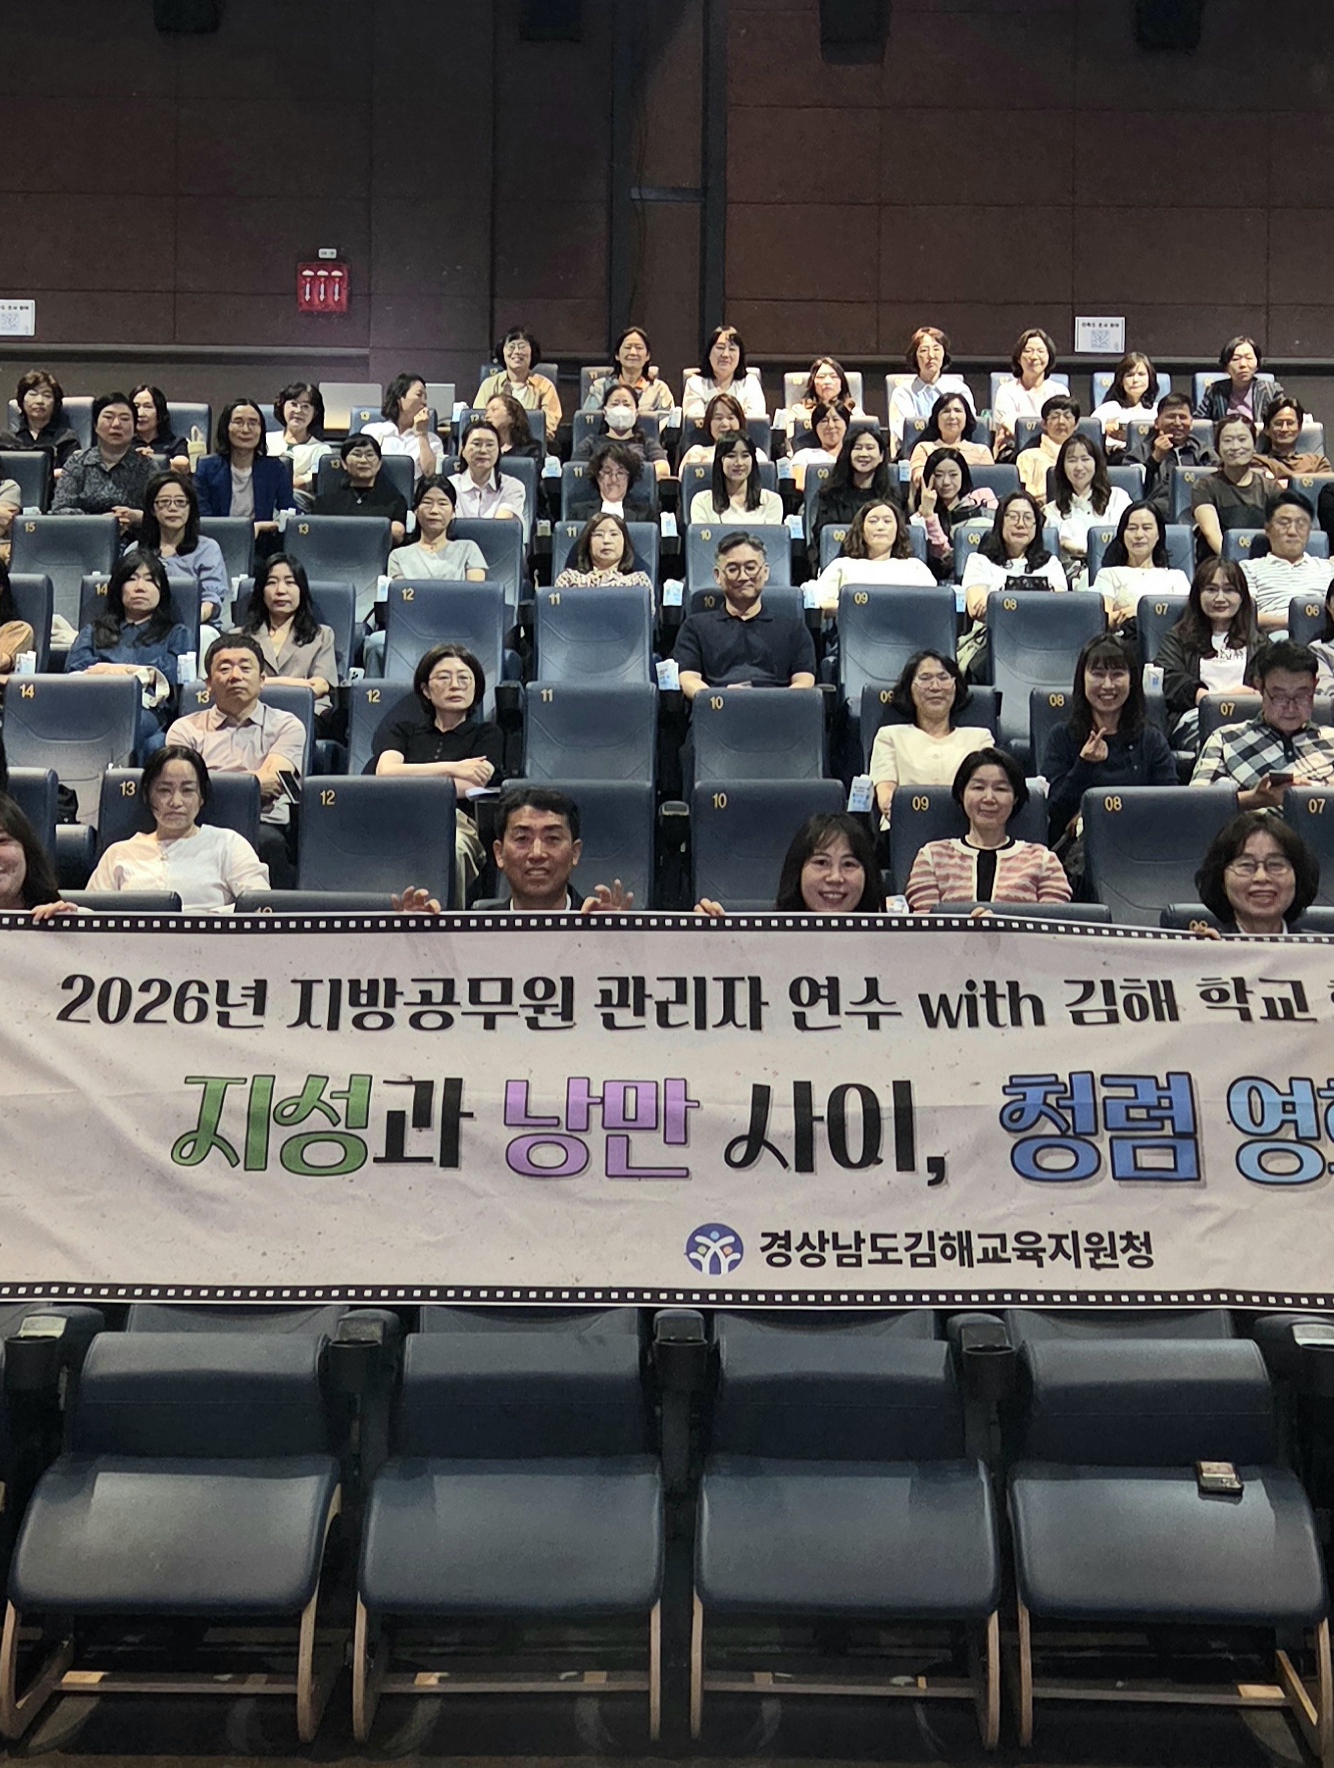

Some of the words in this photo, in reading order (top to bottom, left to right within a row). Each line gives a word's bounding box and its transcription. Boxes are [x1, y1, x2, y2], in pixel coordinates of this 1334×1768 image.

[586, 415, 594, 423] 11
[803, 420, 812, 429] 0
[1026, 422, 1037, 431] 07
[574, 468, 583, 477] 11
[694, 468, 705, 477] 10
[817, 469, 828, 478] 09
[24, 522, 35, 532] 15
[298, 524, 309, 534] 13
[567, 527, 577, 537] 11
[700, 530, 711, 540] 10
[833, 531, 846, 541] 09
[969, 533, 981, 543] 08
[1102, 532, 1113, 542] 07
[95, 584, 108, 594] 14
[402, 588, 414, 599] 12
[549, 593, 560, 605] 11
[703, 597, 714, 607] 10
[854, 592, 867, 603] 09
[1003, 598, 1016, 610] 08
[1155, 604, 1169, 615] 07
[1306, 605, 1319, 616] 06
[19, 684, 34, 697] 14
[541, 689, 553, 701] 11
[196, 691, 210, 703] 13
[367, 690, 380, 703] 12
[1049, 695, 1063, 707] 08
[710, 697, 723, 709] 10
[1220, 702, 1235, 715] 07
[120, 781, 135, 796] 13
[321, 791, 335, 805] 12
[713, 793, 727, 808] 10
[912, 797, 929, 810] 09
[1105, 797, 1121, 811] 08
[1309, 799, 1325, 813] 07
[56, 974, 267, 1030] 2026년
[287, 976, 576, 1032] 지방공무원
[594, 976, 769, 1031] 관리자
[789, 976, 904, 1031] 연수
[918, 979, 1046, 1029] with
[1064, 977, 1181, 1026] 김해
[1197, 976, 1318, 1023] 학교
[170, 1073, 475, 1178] 지성과
[503, 1076, 701, 1180] 낭만
[723, 1079, 949, 1188] 사이,
[999, 1070, 1205, 1185] 청렴
[759, 1229, 1156, 1271] 경상남도김해교육지원청
